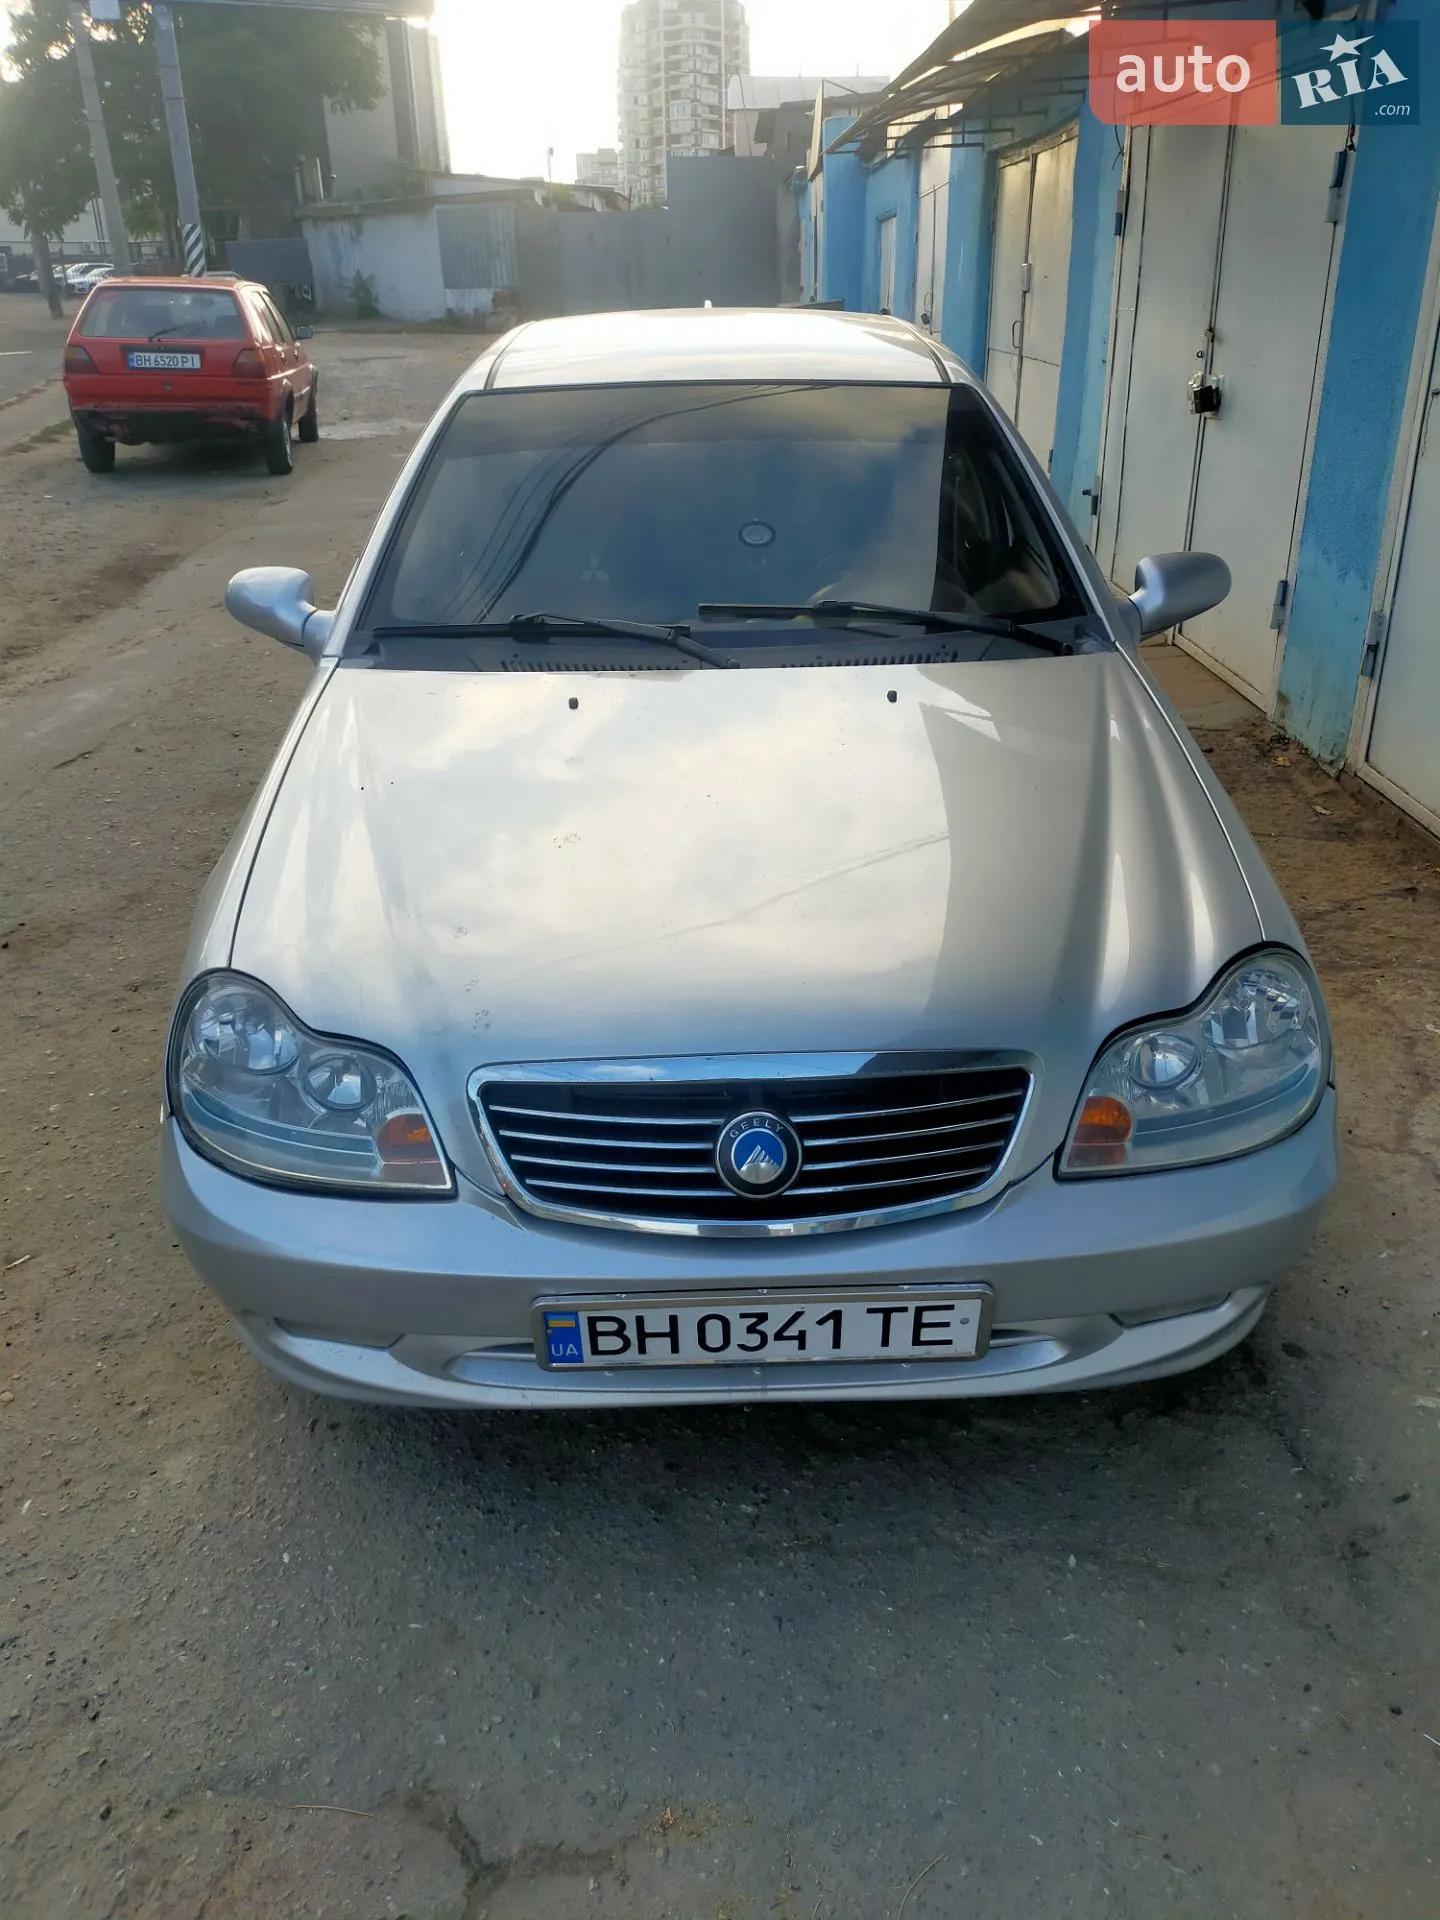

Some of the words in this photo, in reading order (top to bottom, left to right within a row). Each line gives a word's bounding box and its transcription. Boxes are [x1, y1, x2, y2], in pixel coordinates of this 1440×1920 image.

[135, 355, 152, 366] BH
[154, 355, 179, 367] 6520
[729, 1118, 784, 1138] GEELY
[586, 1314, 680, 1356] BH
[696, 1309, 843, 1353] 0341
[866, 1304, 955, 1347] TE
[551, 1343, 579, 1357] UA
